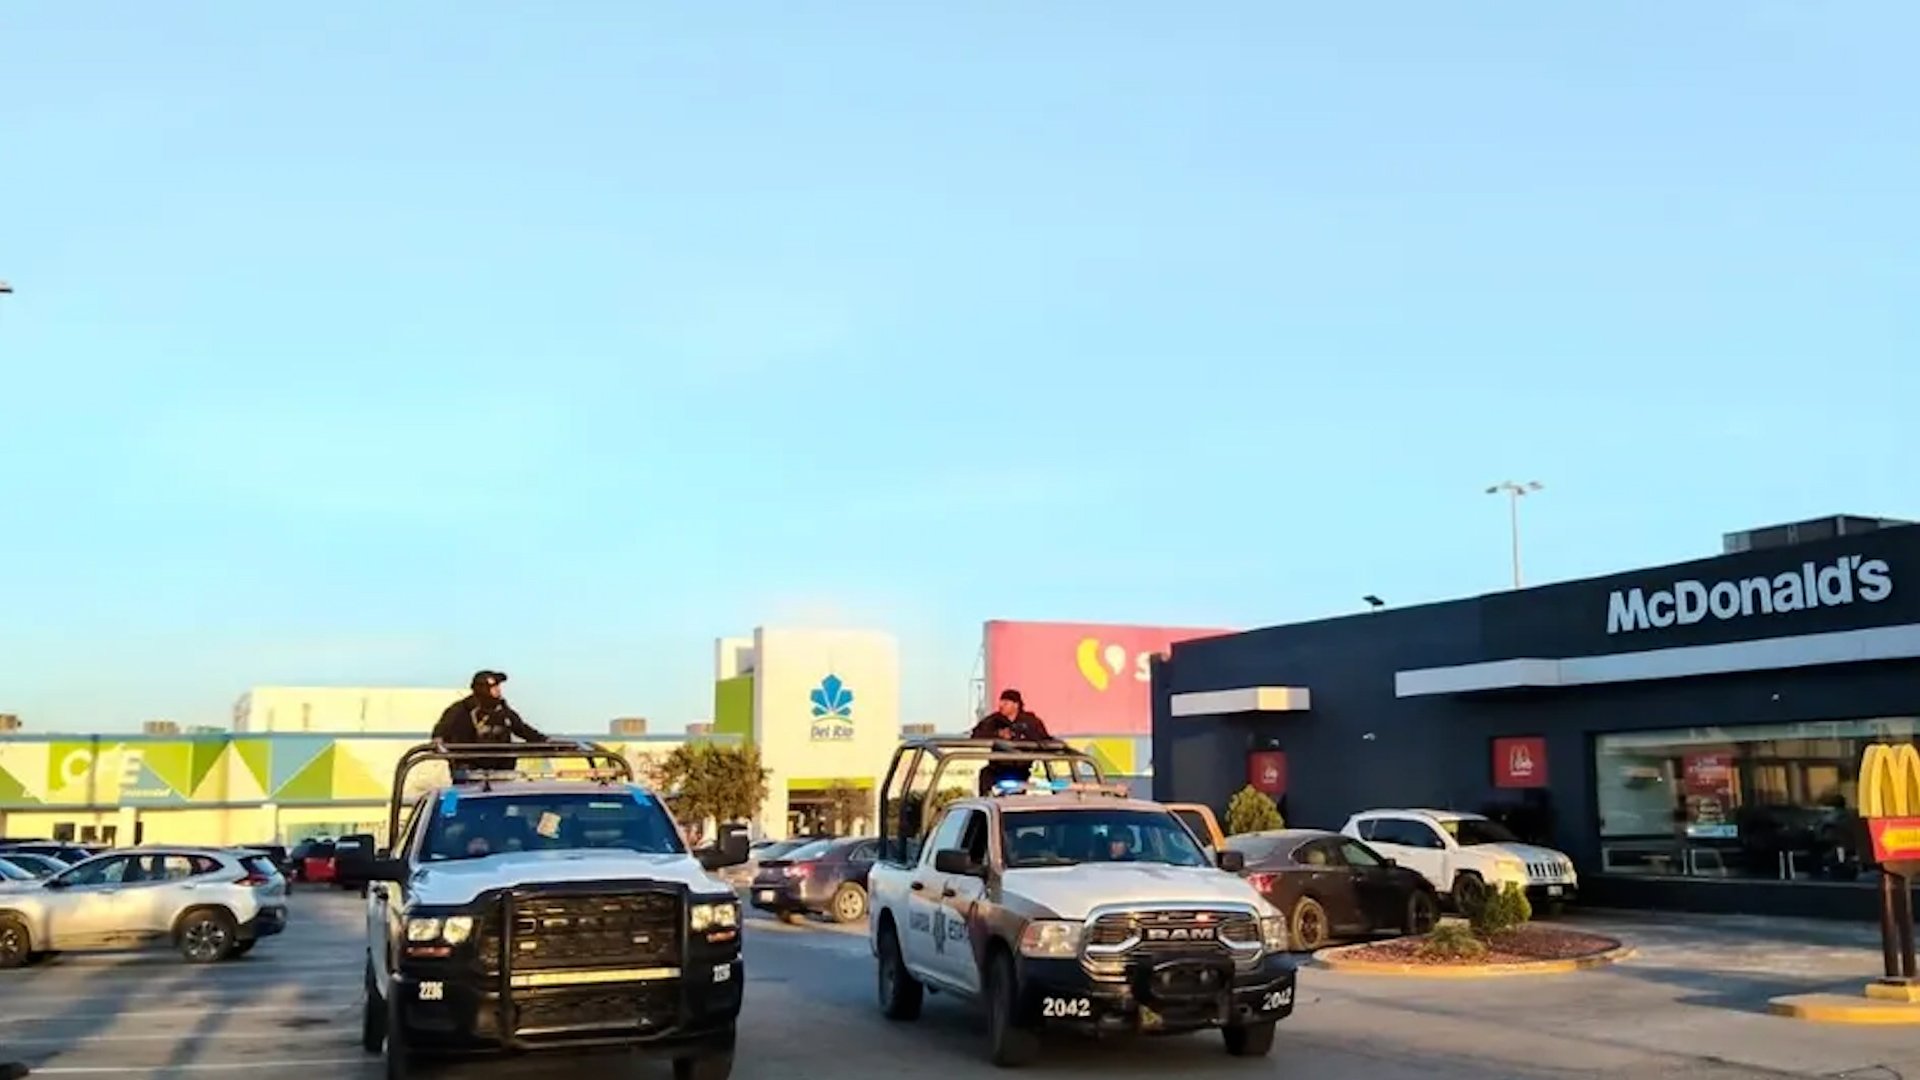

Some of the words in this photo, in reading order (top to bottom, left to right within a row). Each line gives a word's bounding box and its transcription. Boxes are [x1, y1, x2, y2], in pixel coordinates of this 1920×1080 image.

[1606, 554, 1893, 634] McDonald's
[1147, 928, 1215, 940] RAM
[1042, 996, 1091, 1017] 2042
